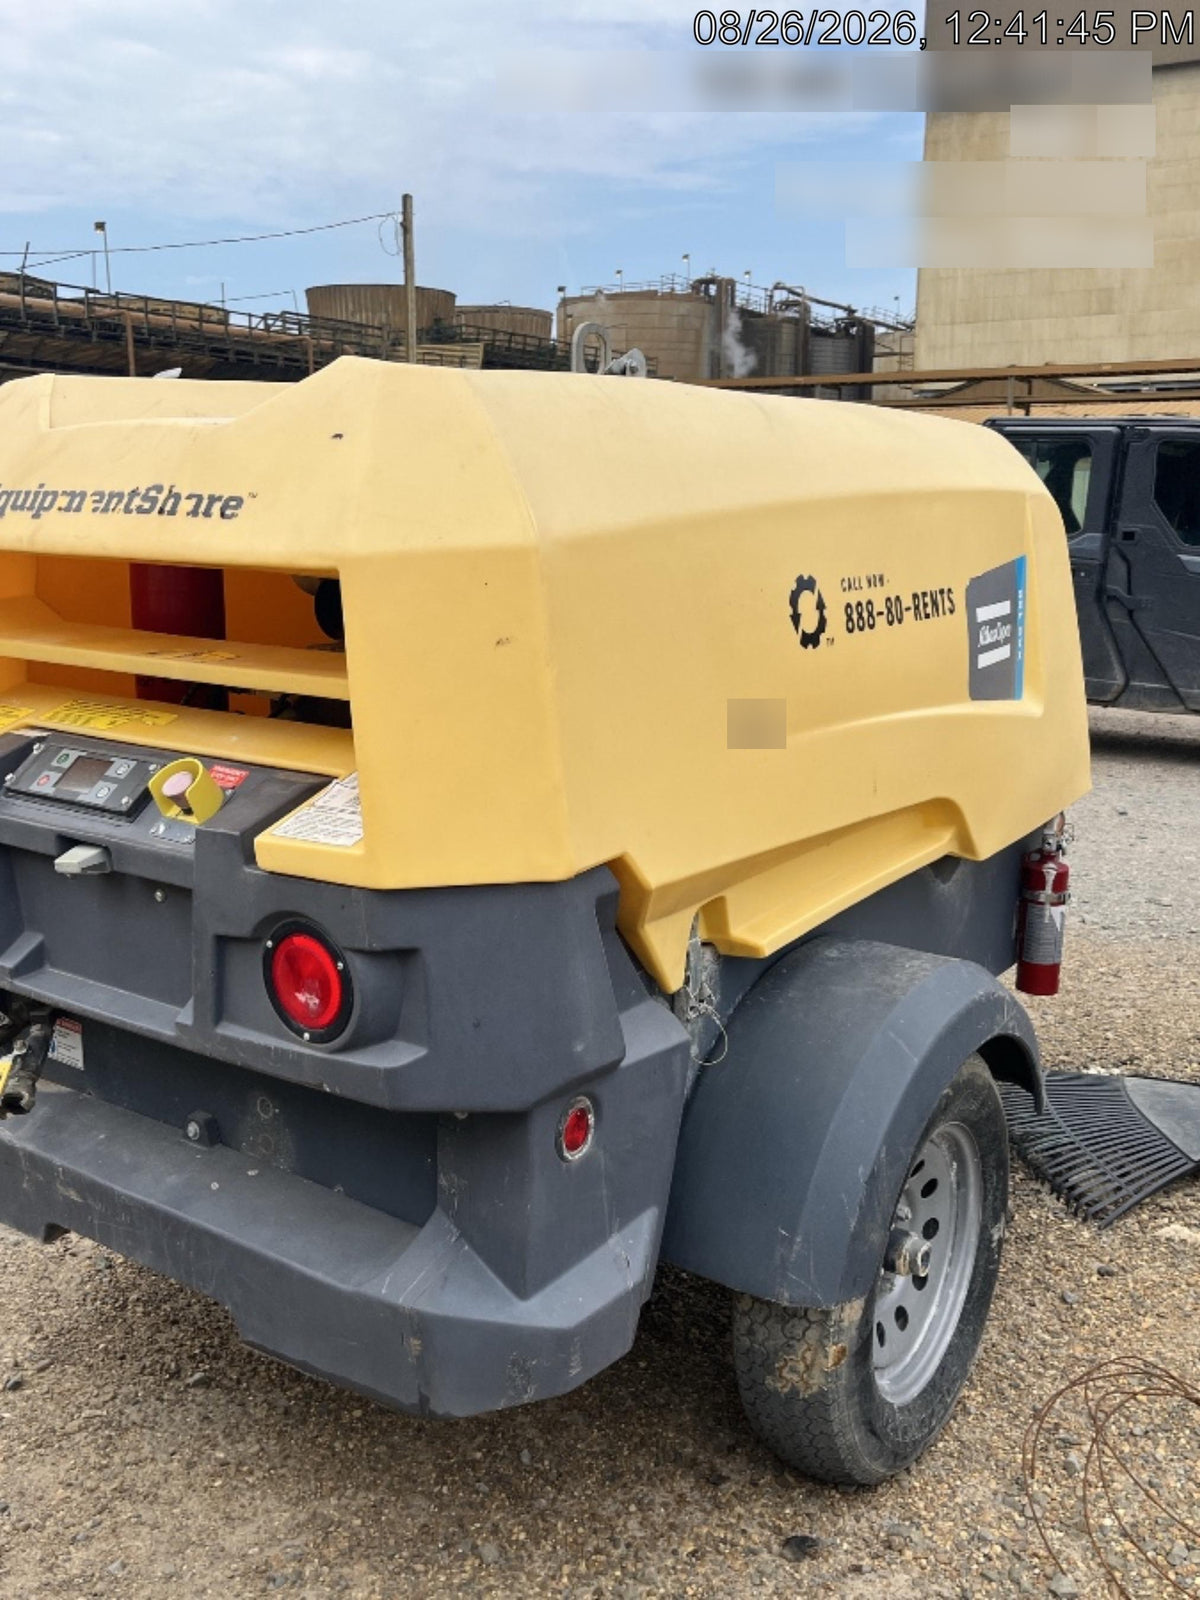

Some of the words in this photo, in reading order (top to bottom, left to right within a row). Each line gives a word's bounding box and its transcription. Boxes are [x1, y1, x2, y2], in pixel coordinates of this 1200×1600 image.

[0, 483, 244, 520] quipmentShare
[840, 576, 863, 592] CALL
[844, 587, 956, 634] 888-80-RENTS
